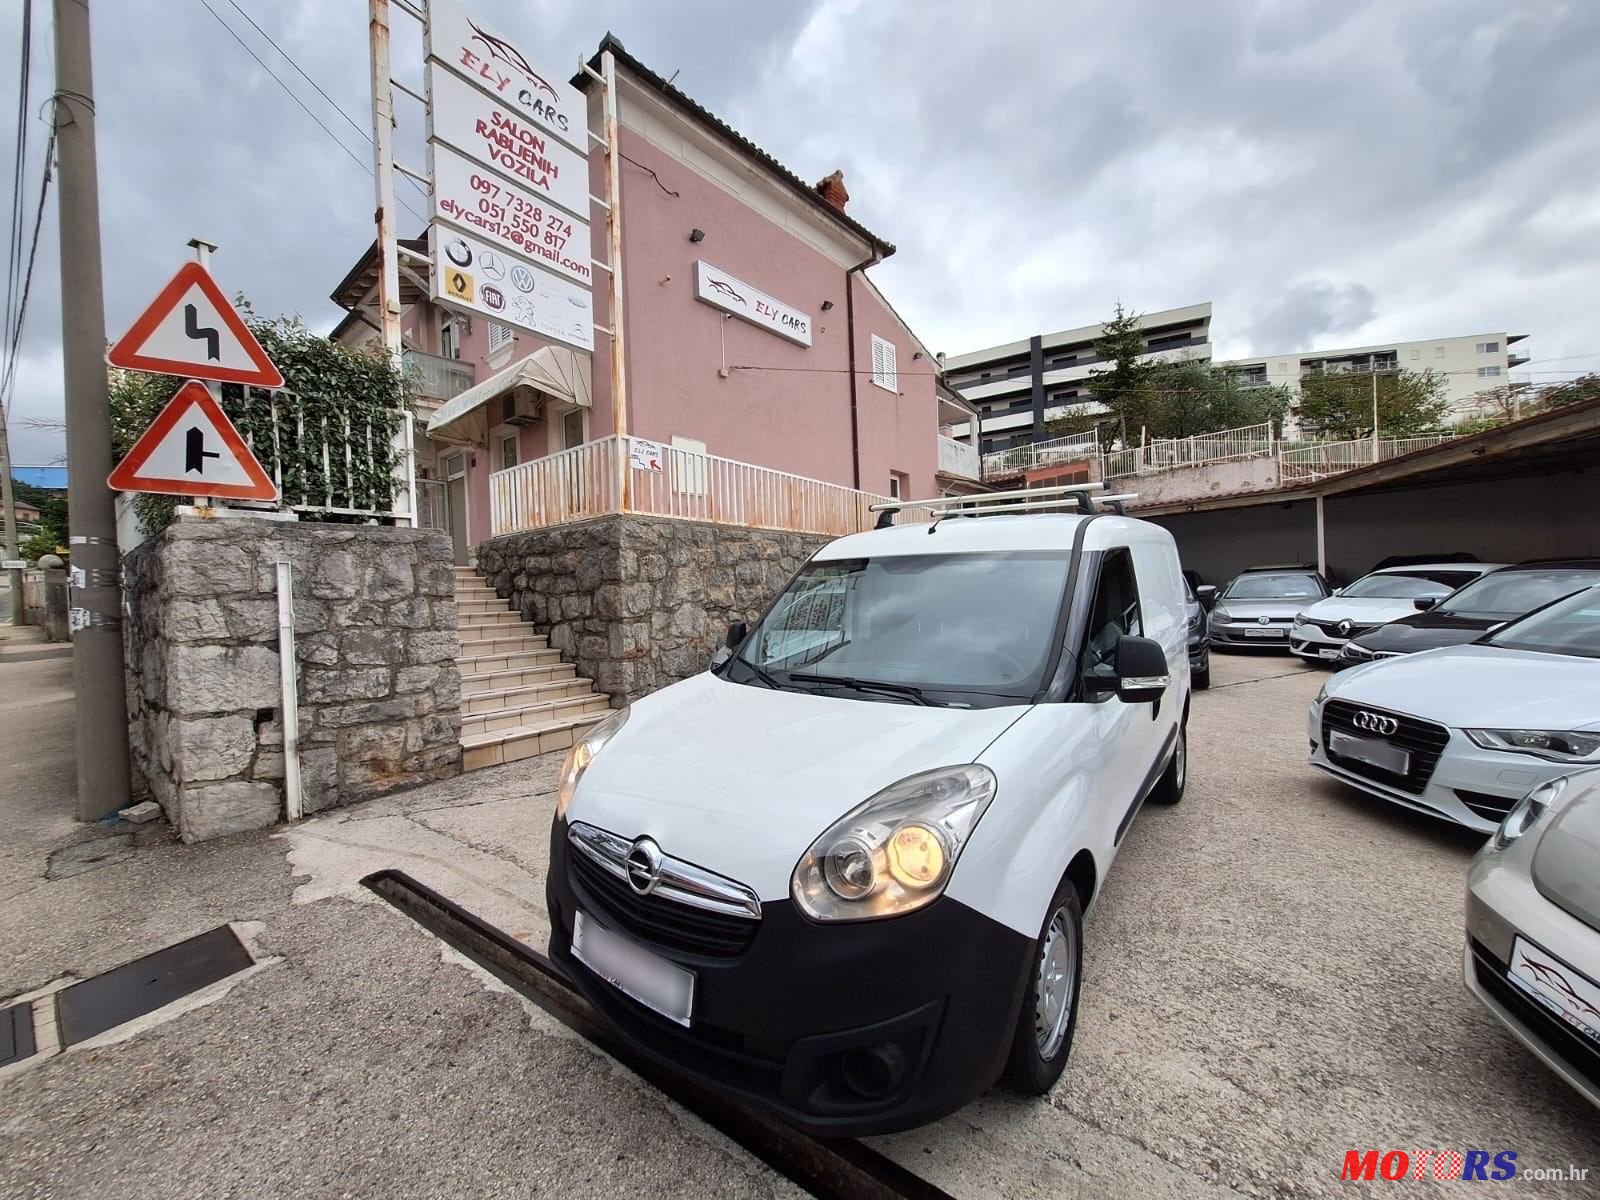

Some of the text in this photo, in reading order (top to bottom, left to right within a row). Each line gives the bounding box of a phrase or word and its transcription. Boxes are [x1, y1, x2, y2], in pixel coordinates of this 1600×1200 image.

[460, 47, 568, 132] ELY CARS
[475, 119, 559, 179] RABLJENIH
[491, 111, 545, 154] SALON
[488, 143, 550, 191] VOZILA
[470, 175, 572, 238] 097 7328 274
[479, 199, 566, 250] 051 550 817
[440, 199, 590, 278] elycars12@gmail.com
[485, 289, 501, 306] FIAT
[755, 300, 807, 334] ELY CARS
